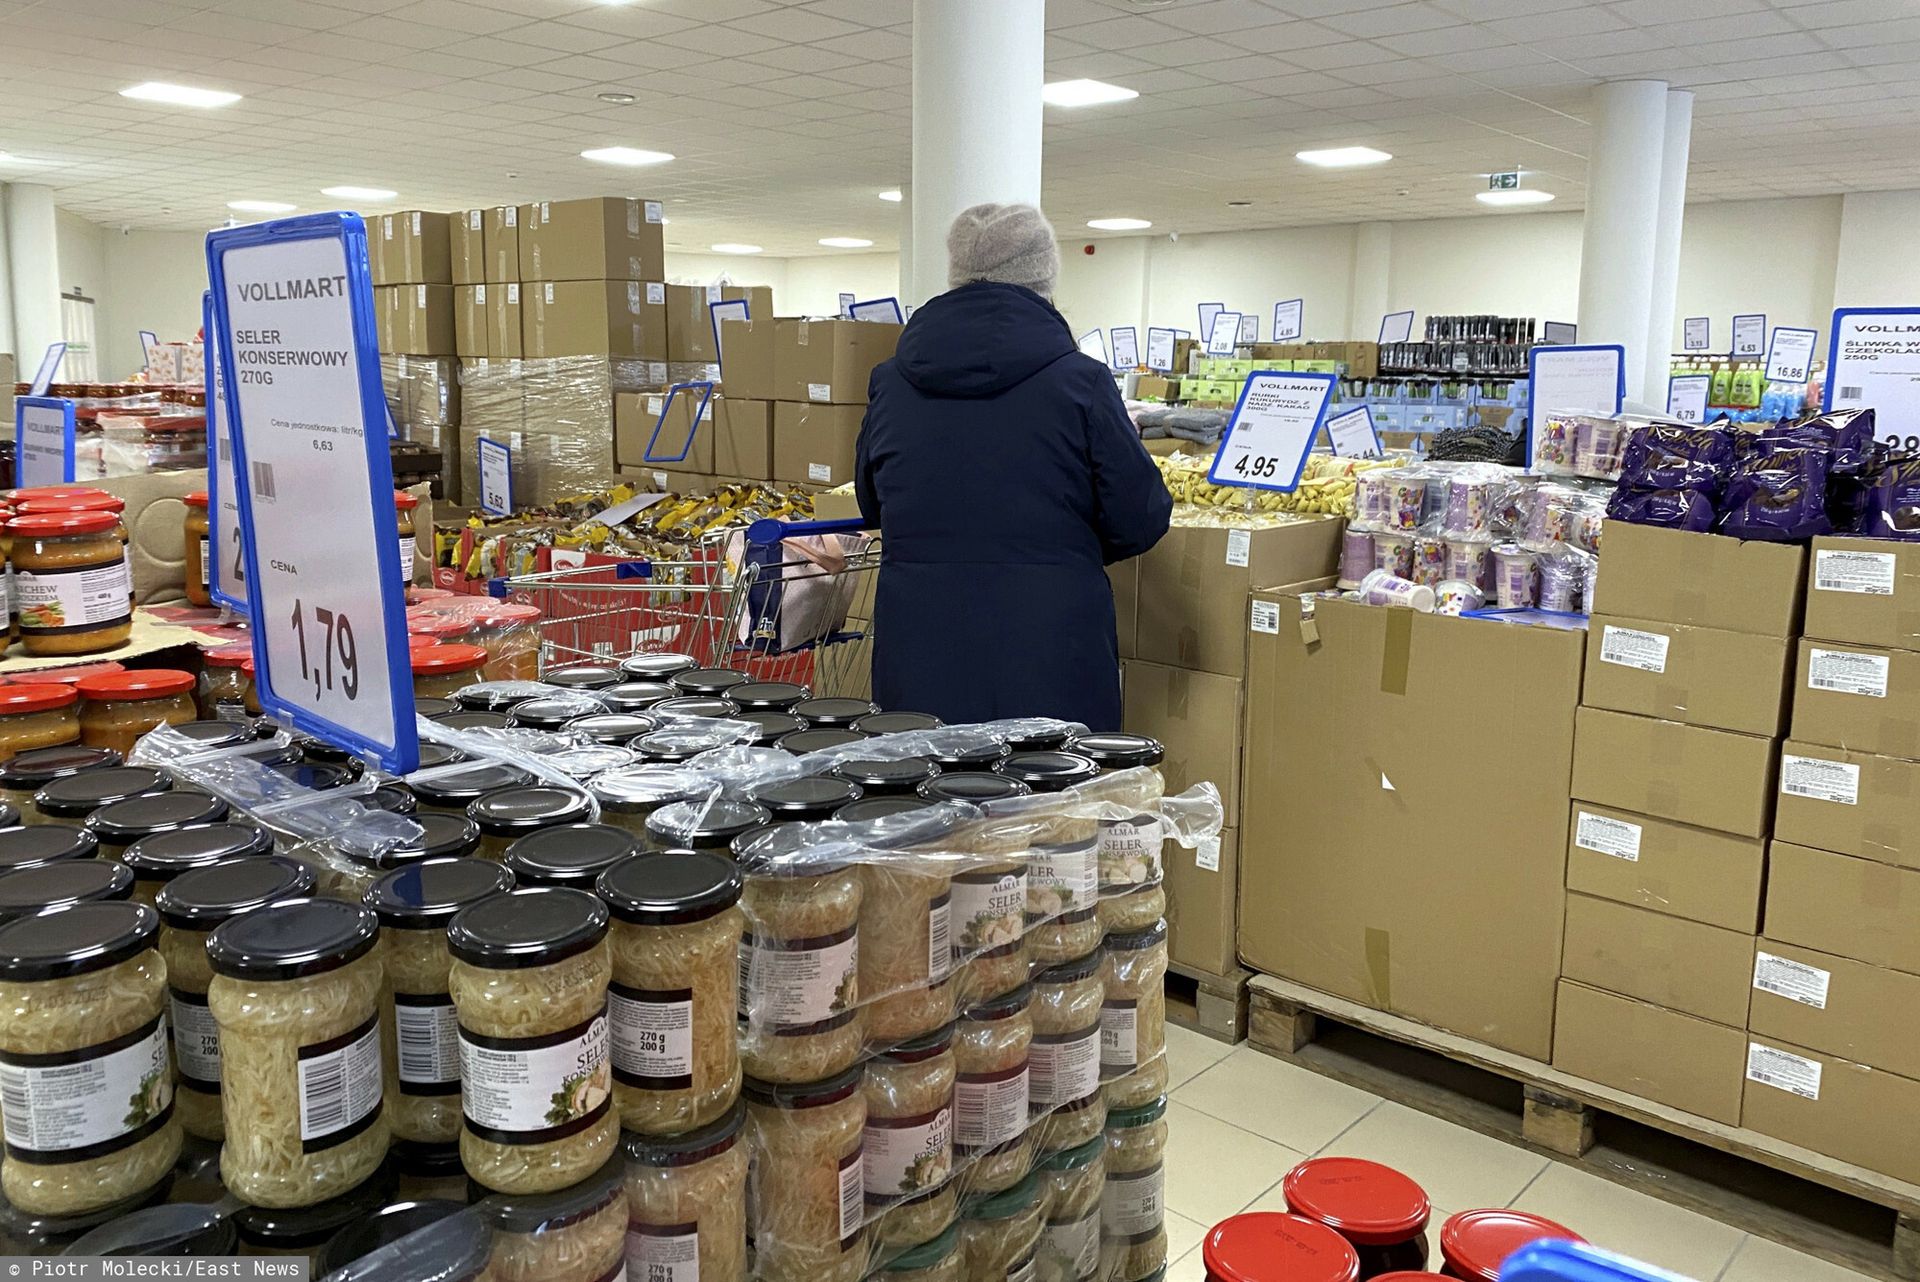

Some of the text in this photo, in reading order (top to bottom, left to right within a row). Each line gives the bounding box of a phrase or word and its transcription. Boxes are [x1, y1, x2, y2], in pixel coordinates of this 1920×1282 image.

[237, 276, 346, 302] VOLLMART
[236, 330, 282, 345] SELER
[1845, 339, 1903, 347] ŚLIWKA
[238, 350, 348, 366] KONSERWOWY
[241, 370, 273, 385] 270G
[1260, 383, 1326, 392] VOLLMART
[1676, 410, 1695, 421] 6,79
[270, 418, 290, 428] Cena
[313, 439, 333, 452] 6,63
[1234, 454, 1279, 479] 4,95
[270, 559, 298, 576] CENA
[291, 598, 358, 702] 1,79
[1107, 828, 1140, 837] ALMAR
[1104, 839, 1142, 850] SELER
[988, 891, 1021, 910] SELER
[200, 1035, 217, 1045] 270
[640, 1031, 666, 1044] 270 g
[201, 1045, 218, 1055] 200
[640, 1042, 666, 1053] 200 g
